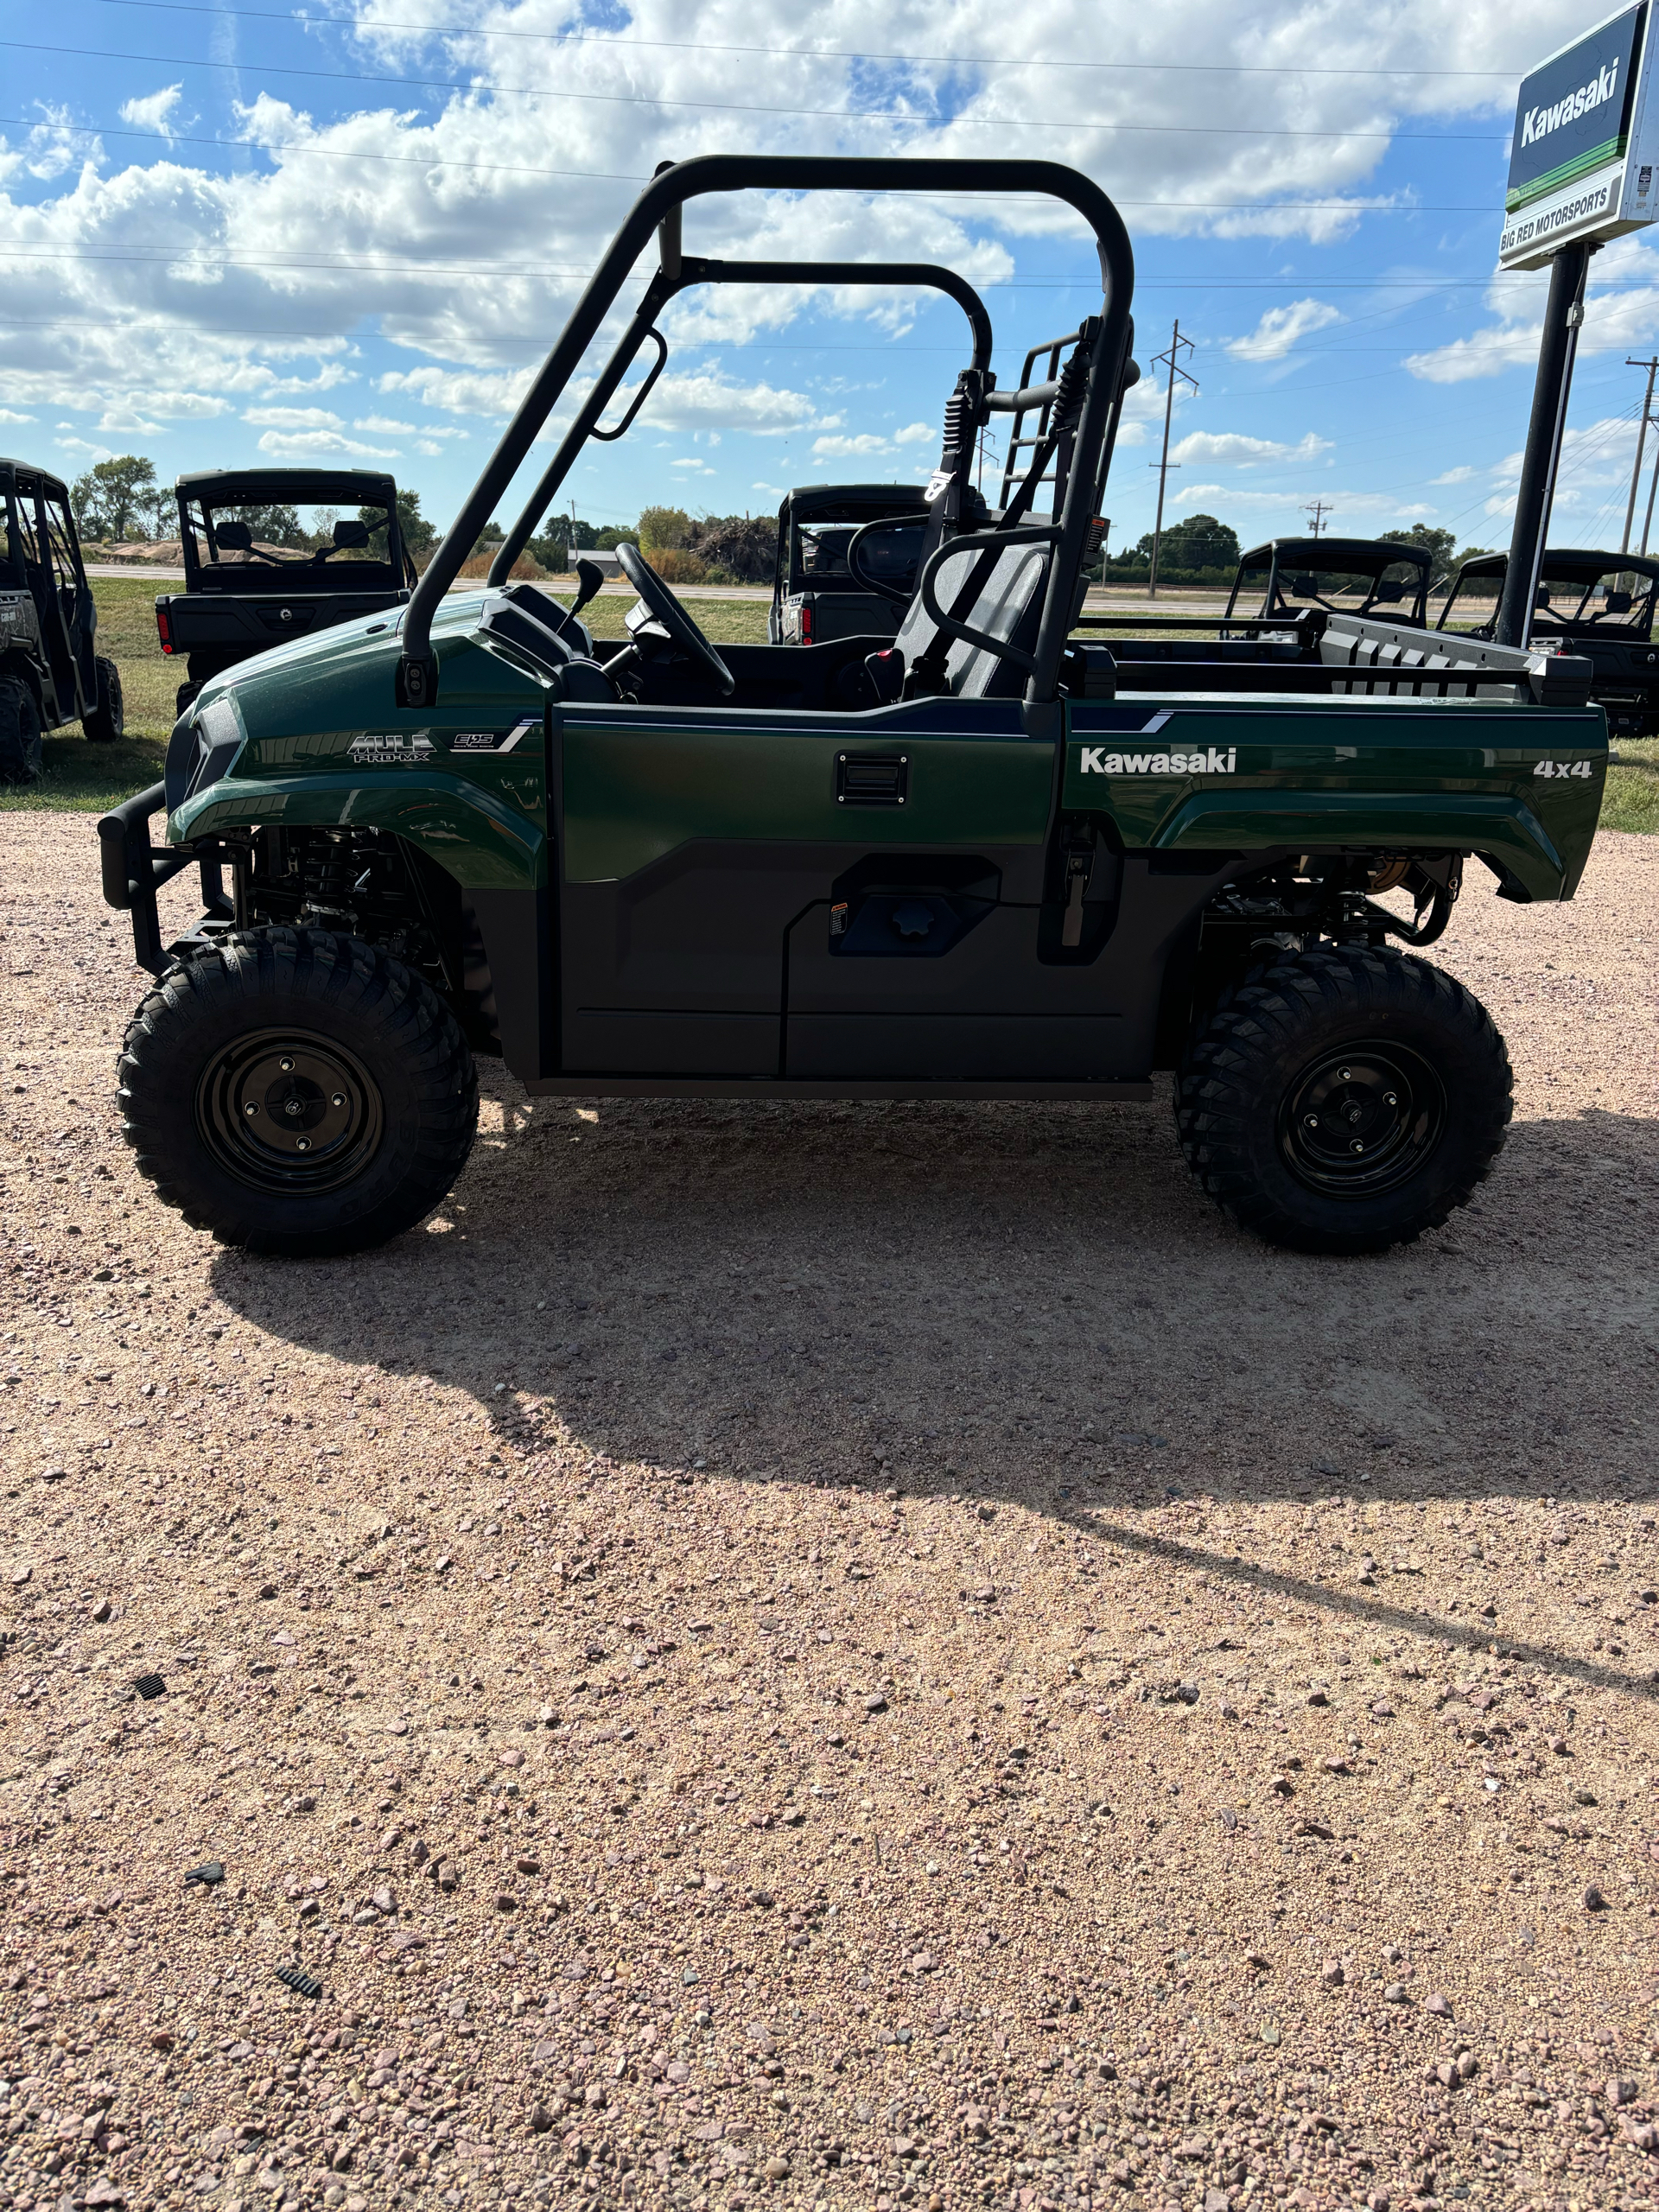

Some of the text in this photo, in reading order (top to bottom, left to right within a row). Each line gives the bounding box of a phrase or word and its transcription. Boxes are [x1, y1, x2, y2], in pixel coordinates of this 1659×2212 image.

[1521, 56, 1619, 149] Kawasaki
[1500, 188, 1607, 251] BIG RED MOTORSPORTS
[346, 734, 437, 754] MULE
[353, 753, 430, 763] PRO-MX
[1080, 747, 1236, 774] Kawasaki
[1533, 760, 1592, 779] 4x4
